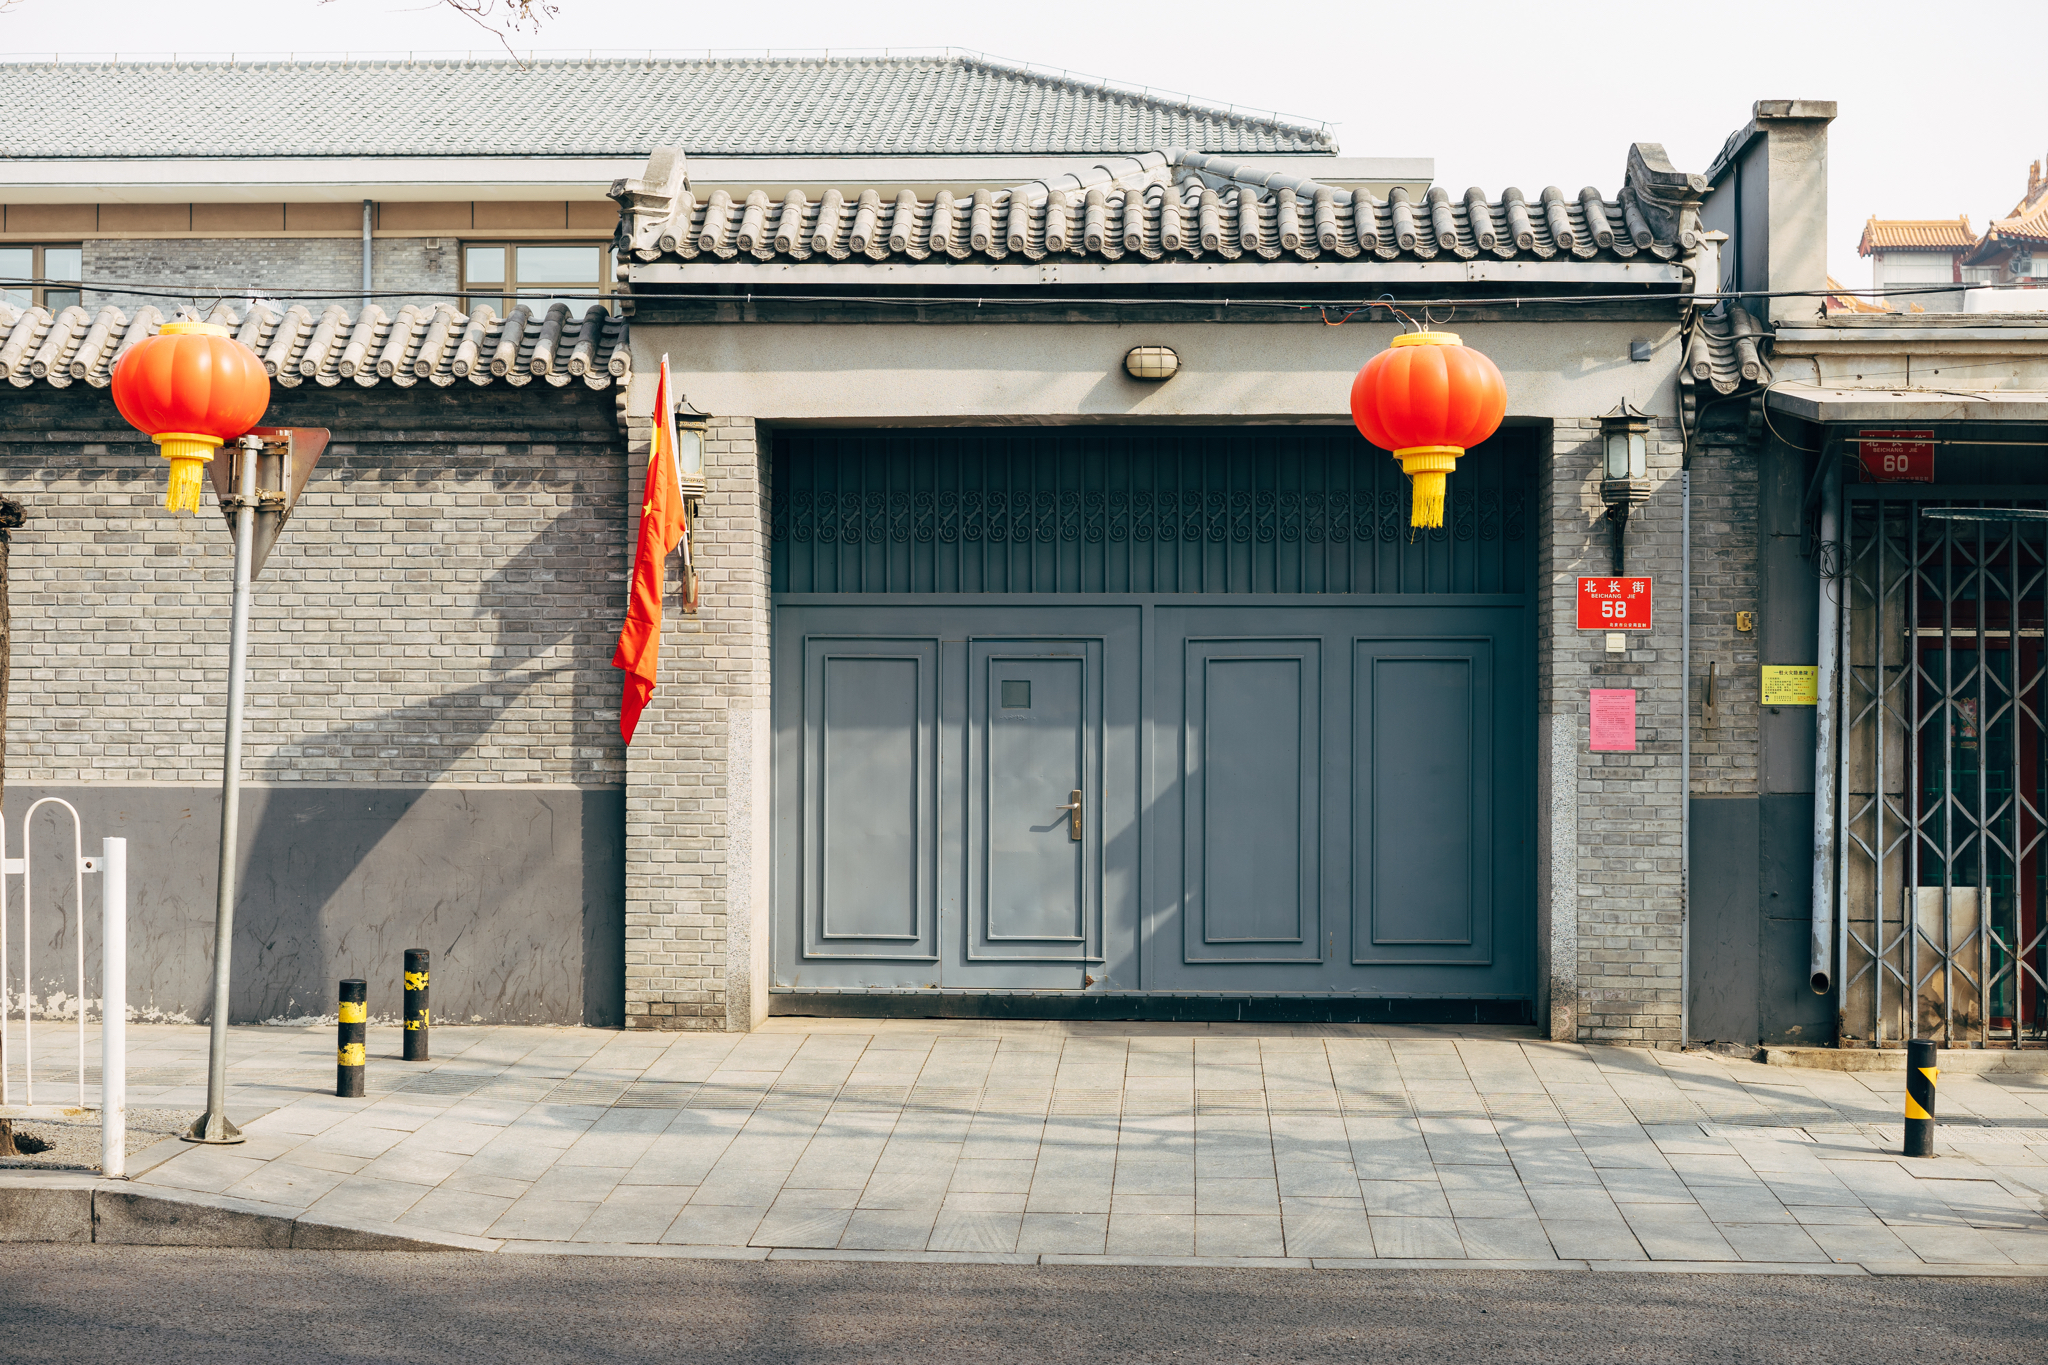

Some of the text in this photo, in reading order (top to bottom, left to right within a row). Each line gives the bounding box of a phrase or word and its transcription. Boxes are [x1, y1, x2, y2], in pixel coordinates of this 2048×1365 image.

[1883, 454, 1909, 472] 60
[1584, 580, 1645, 594] 北长街
[1601, 600, 1627, 618] 58
